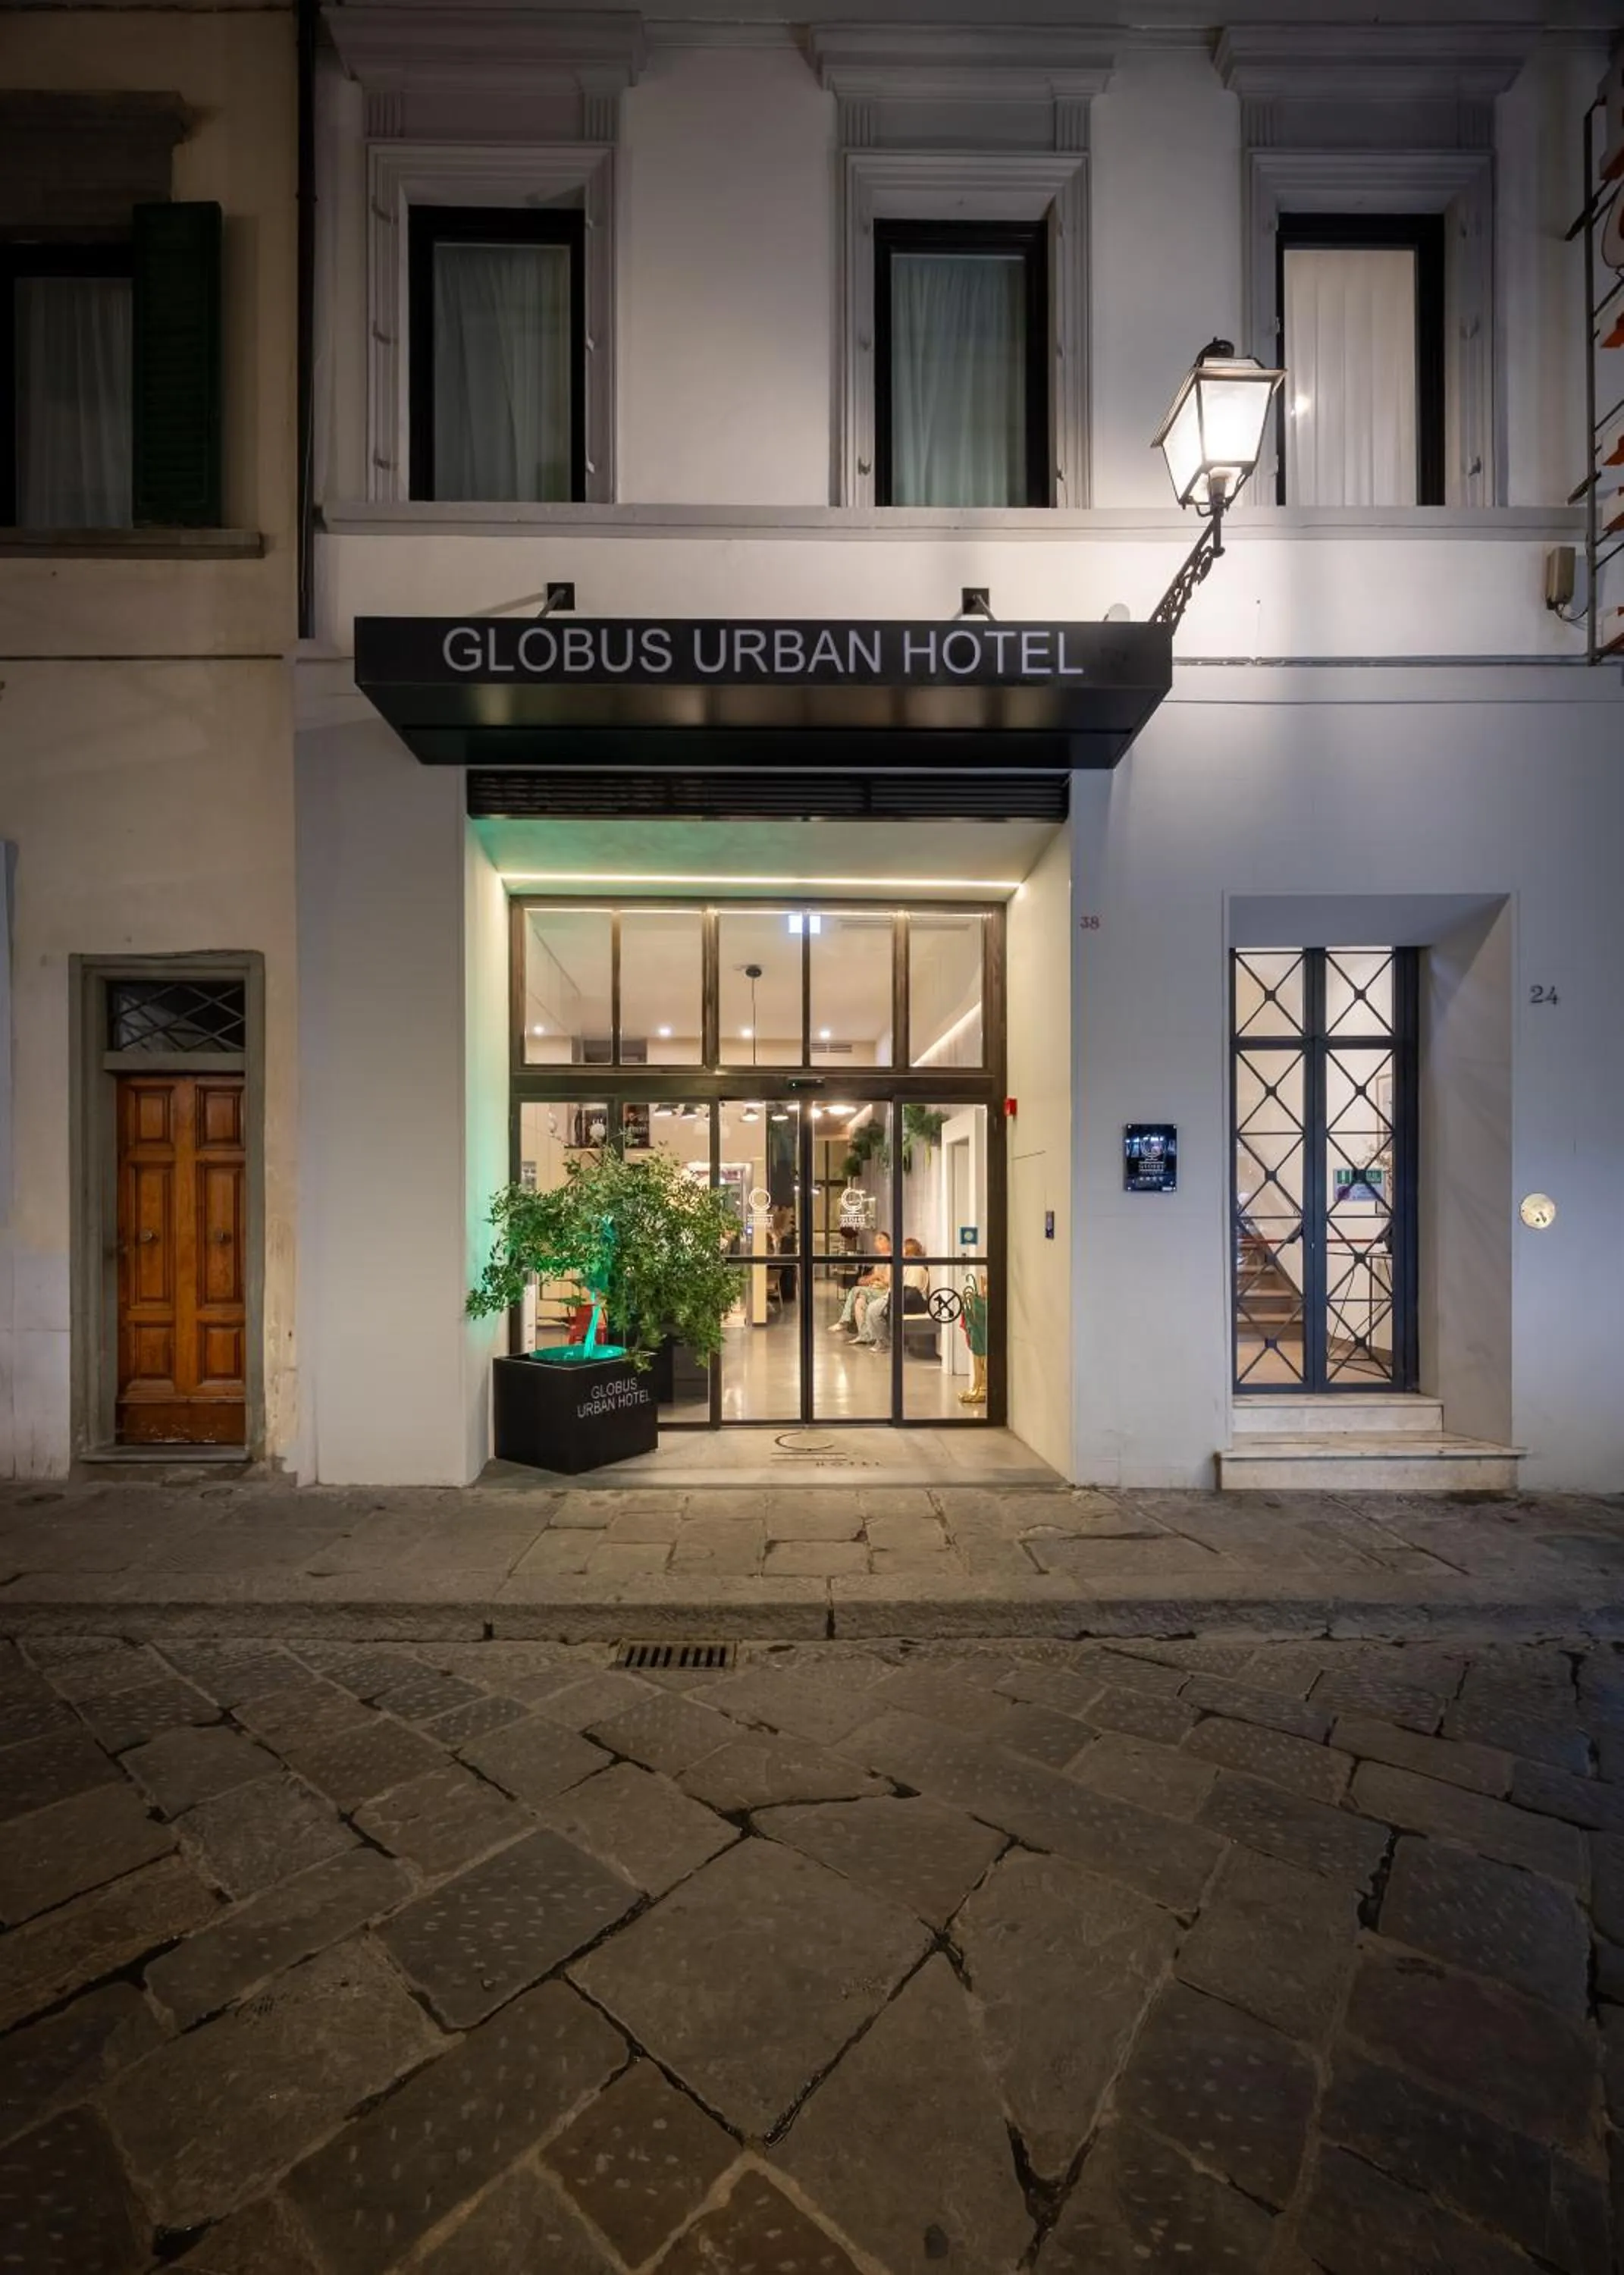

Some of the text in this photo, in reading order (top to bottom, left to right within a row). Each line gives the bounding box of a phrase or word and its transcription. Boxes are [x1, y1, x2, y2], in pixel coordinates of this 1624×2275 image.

[442, 626, 1084, 675] GLOBUS URBAN HOTEL
[1080, 915, 1100, 930] 38
[1530, 984, 1559, 1005] 24
[591, 1377, 638, 1400] GLOBUS
[577, 1389, 651, 1418] URBAN HOTEL
